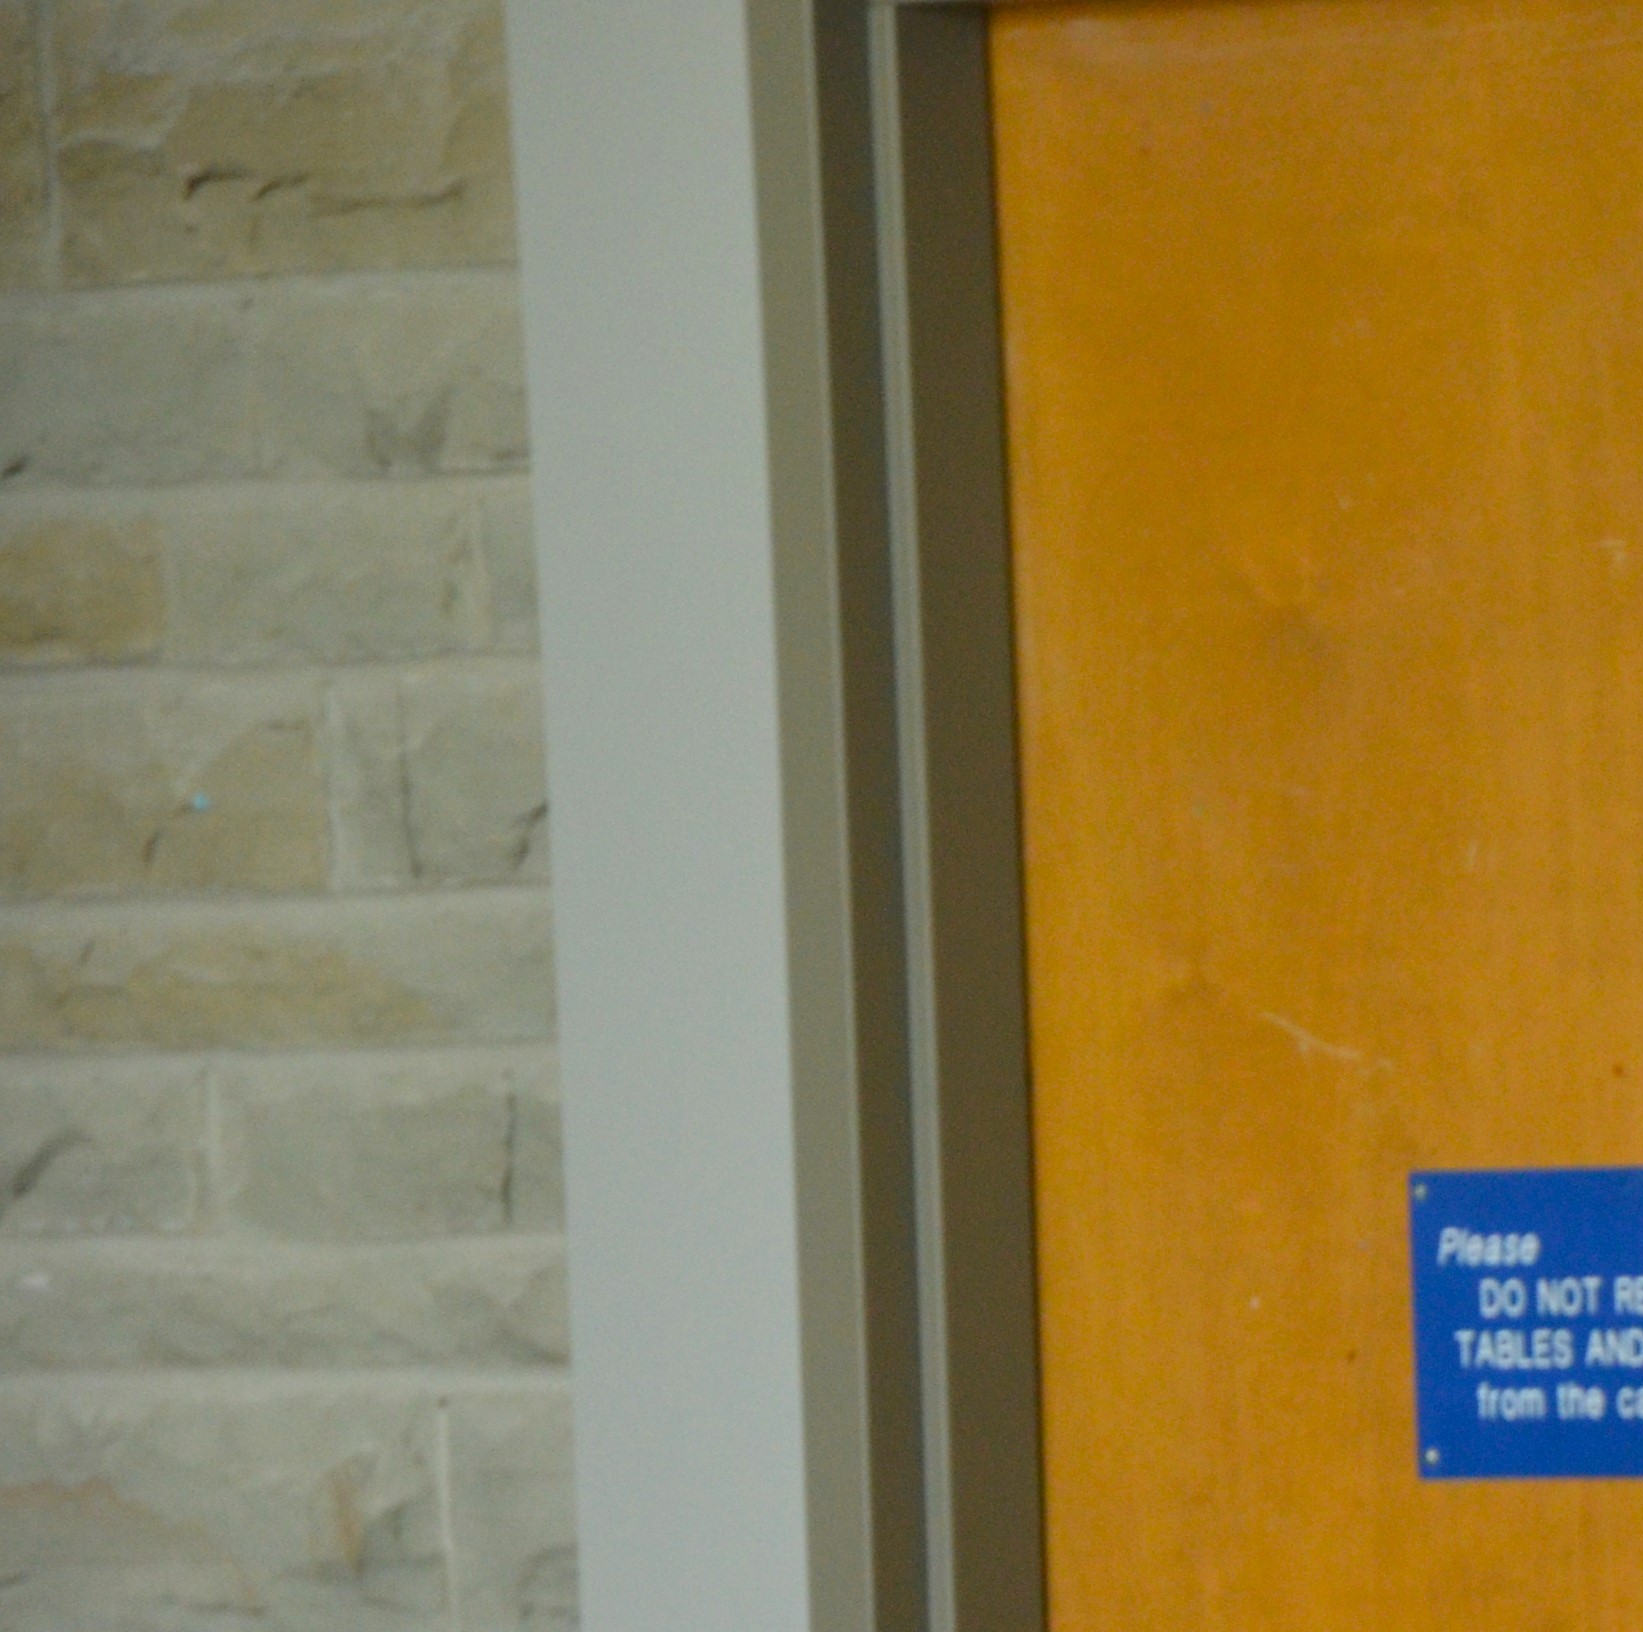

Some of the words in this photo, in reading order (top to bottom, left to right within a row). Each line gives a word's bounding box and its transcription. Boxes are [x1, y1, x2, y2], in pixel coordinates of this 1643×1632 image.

[1437, 1226, 1541, 1266] Please
[1478, 1277, 1526, 1318] DO
[1536, 1275, 1600, 1316] NOT
[1454, 1329, 1574, 1369] TABLES
[1476, 1381, 1547, 1421] from
[1556, 1381, 1607, 1420] the
